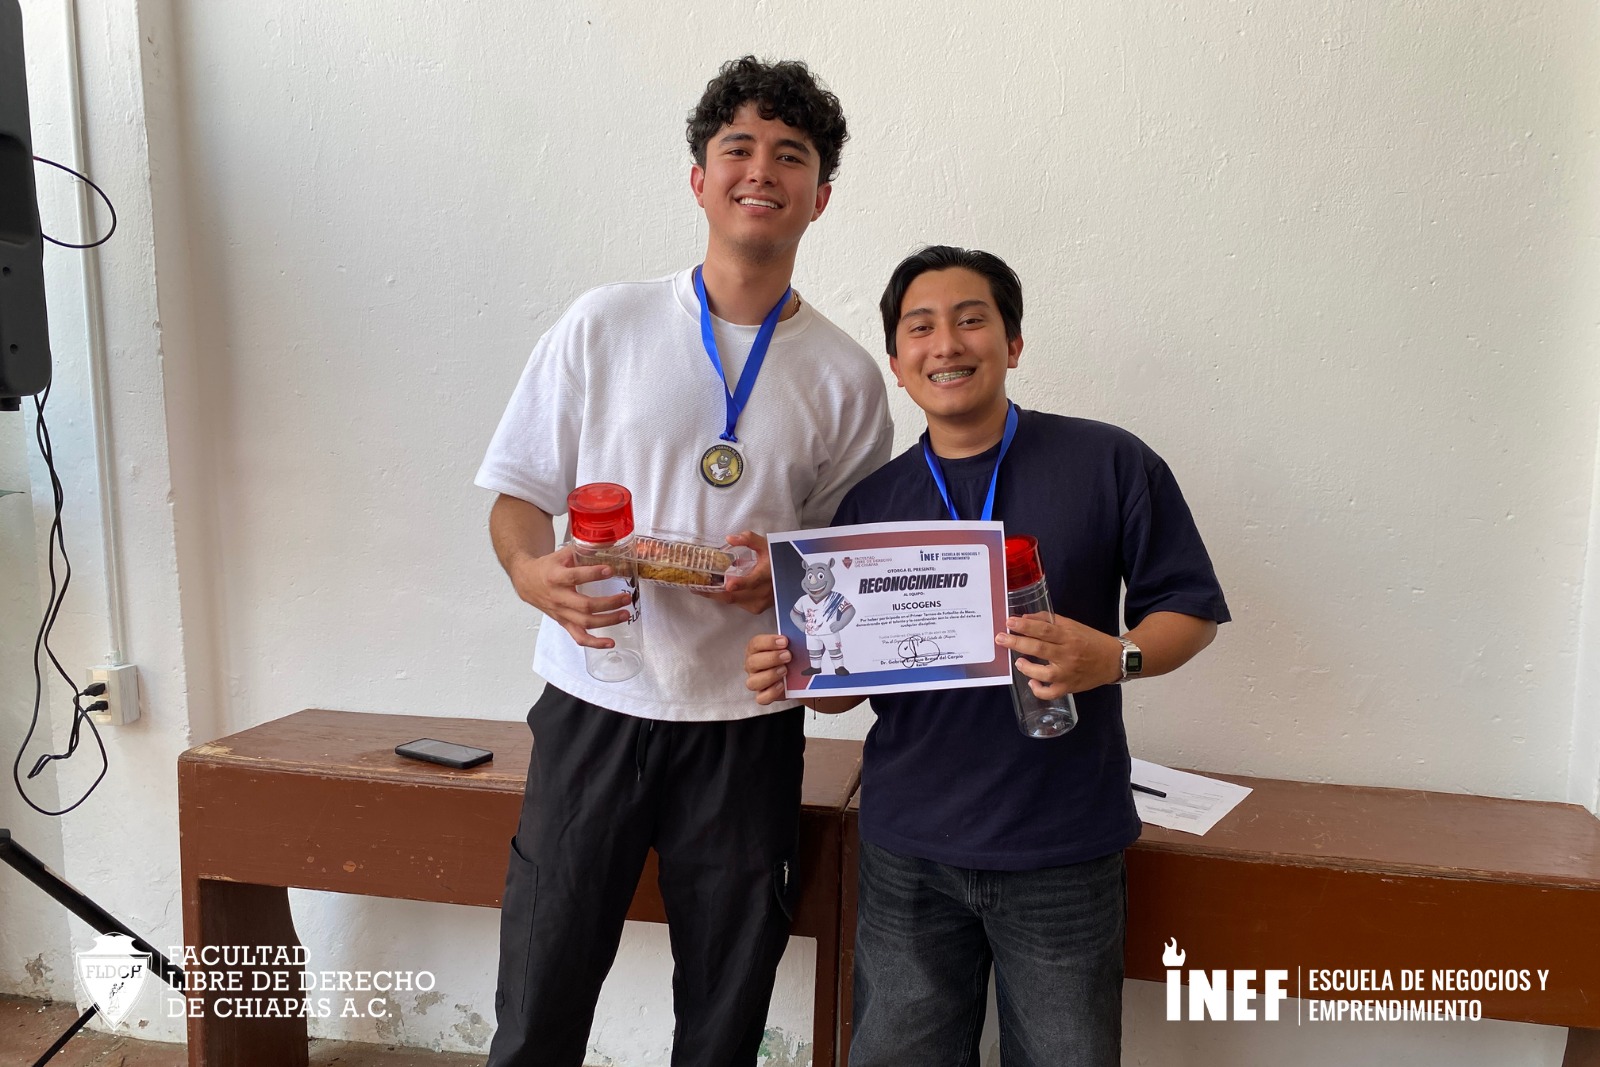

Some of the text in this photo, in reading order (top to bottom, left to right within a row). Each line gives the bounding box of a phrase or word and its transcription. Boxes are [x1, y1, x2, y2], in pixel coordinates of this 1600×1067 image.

[920, 551, 940, 562] INEF
[858, 572, 968, 594] RECONOCIMIENTO
[892, 600, 942, 611] IUSCOGENS
